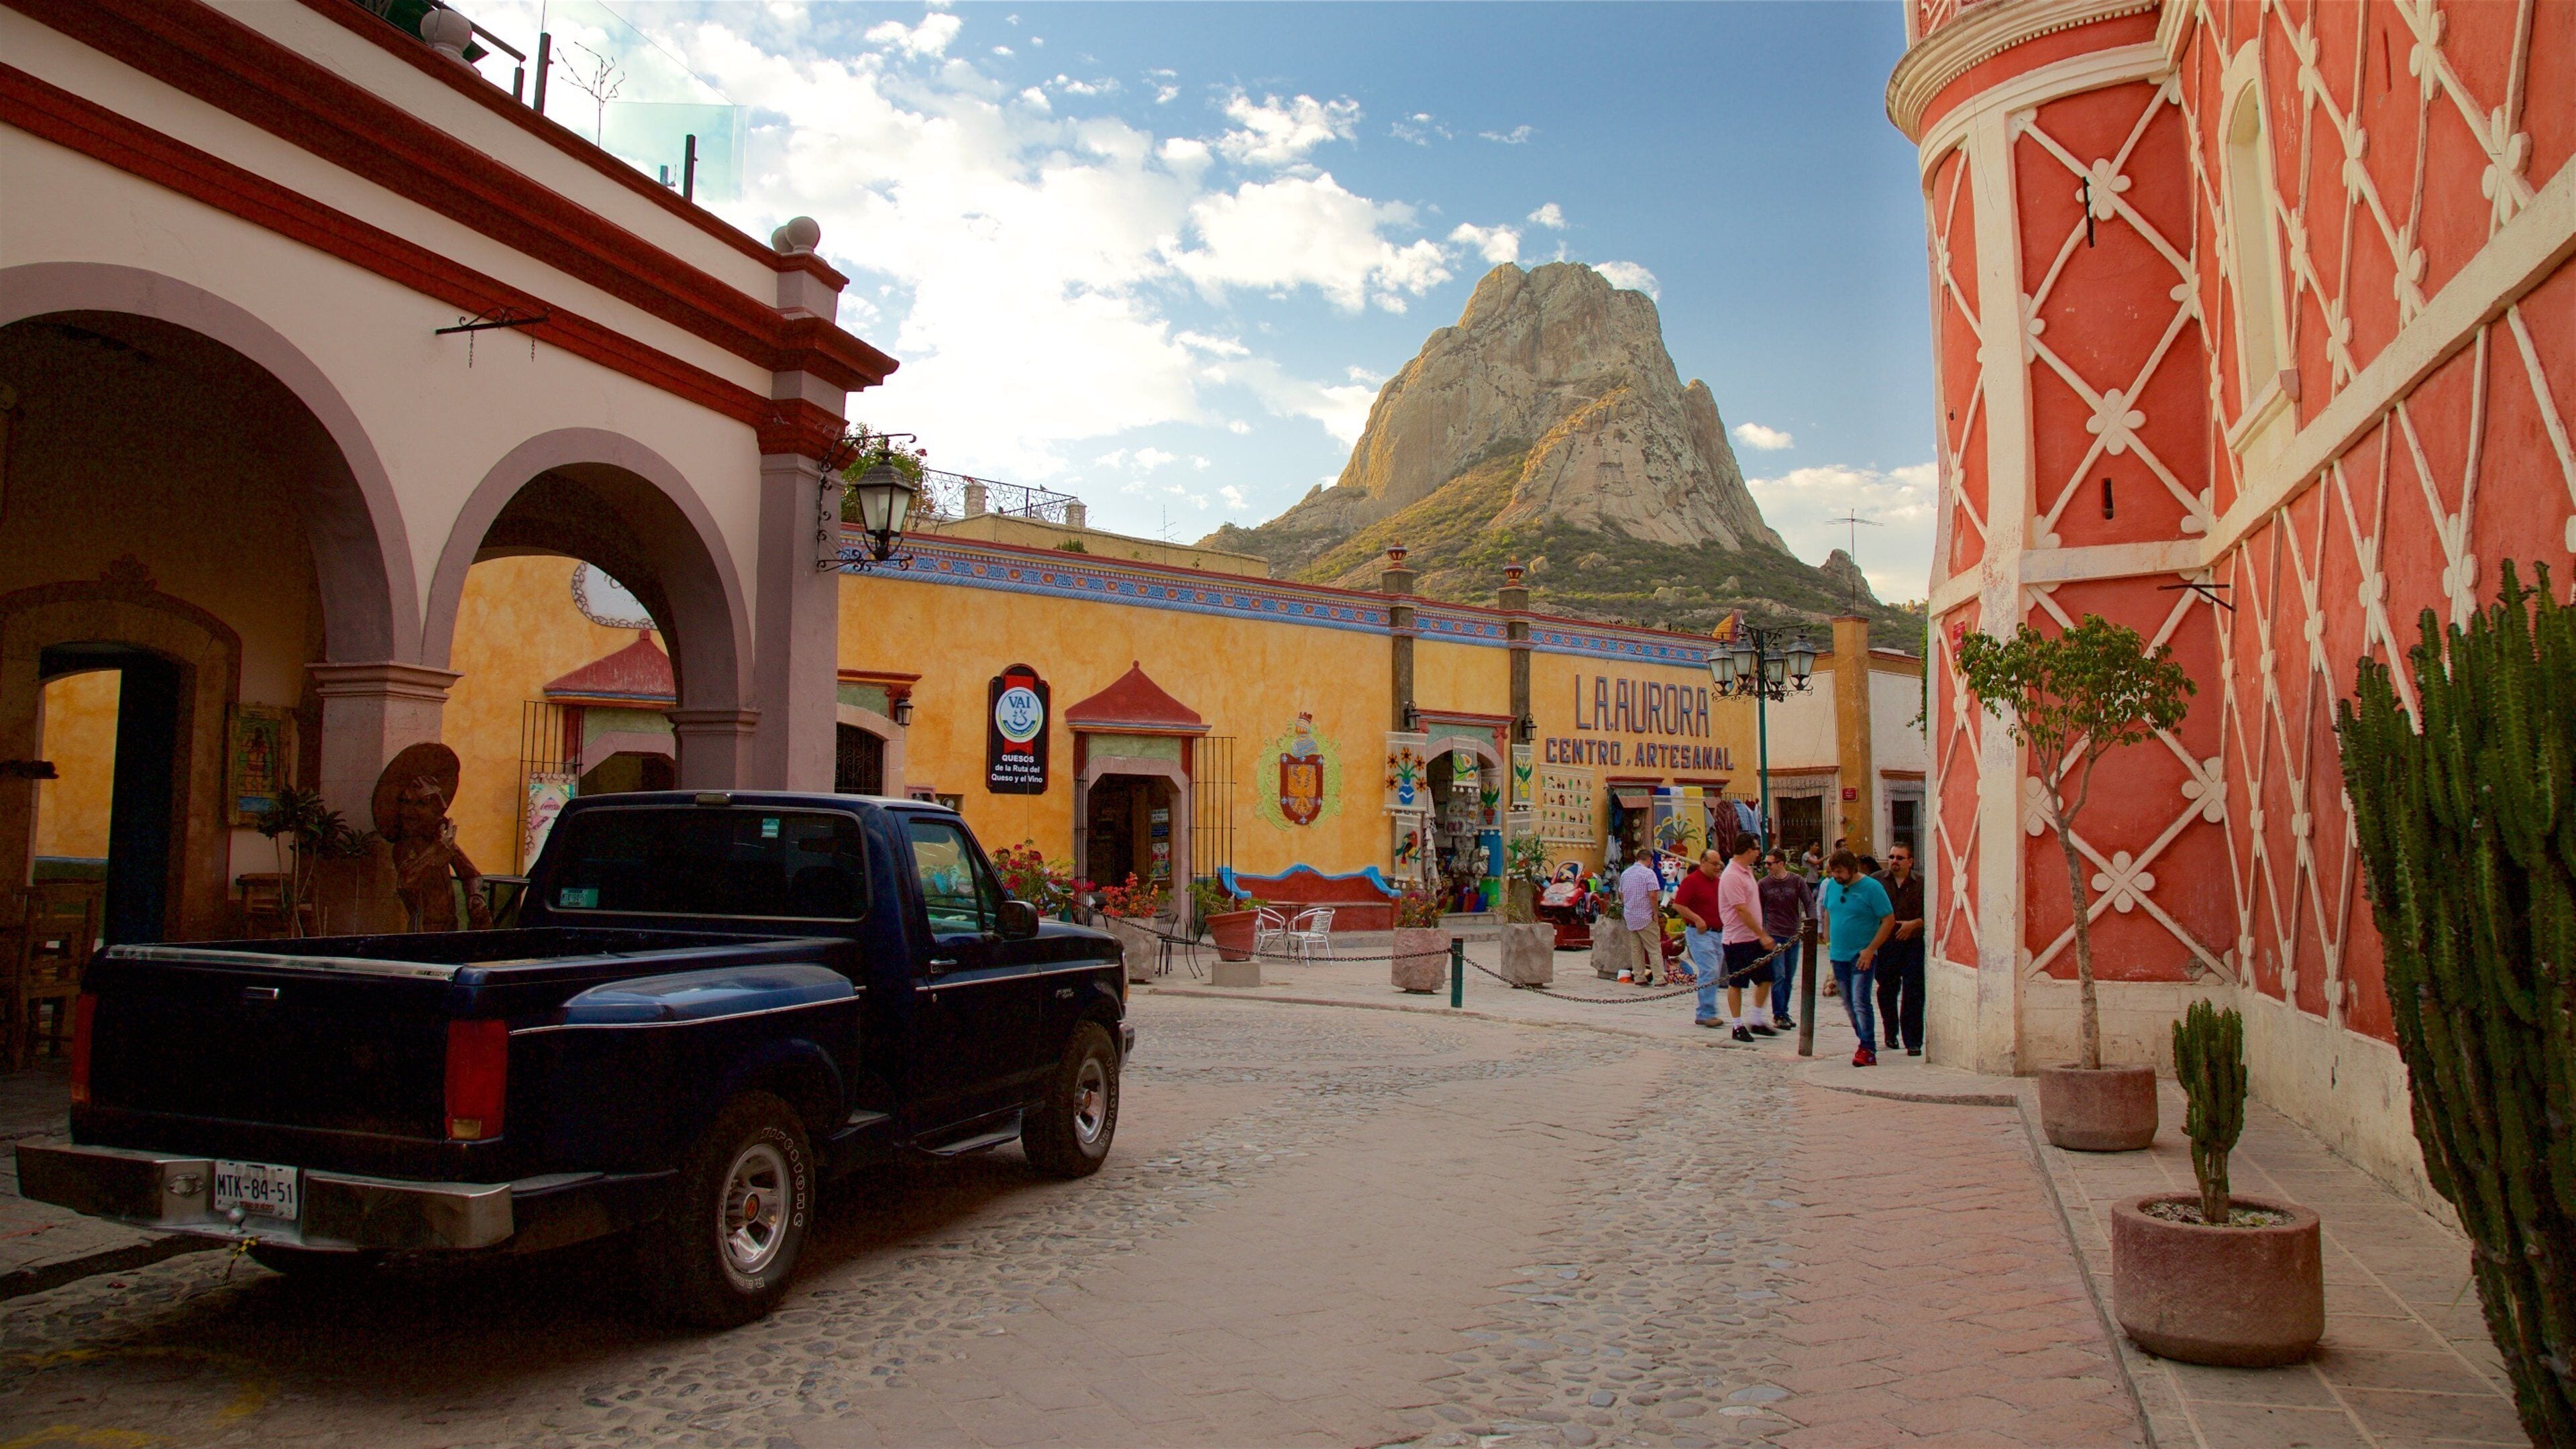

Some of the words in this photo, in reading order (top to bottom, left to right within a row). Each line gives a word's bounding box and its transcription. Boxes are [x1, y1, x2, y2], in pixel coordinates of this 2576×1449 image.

[1008, 696, 1030, 708] VAI
[1576, 674, 1610, 731] LA
[1615, 679, 1710, 738] AURORA
[1002, 754, 1034, 763] QUESOS
[1546, 738, 1621, 765] CENTRO
[1635, 742, 1734, 770] ARTESANAL
[991, 773, 1013, 782] Queso
[1028, 775, 1042, 783] Vino
